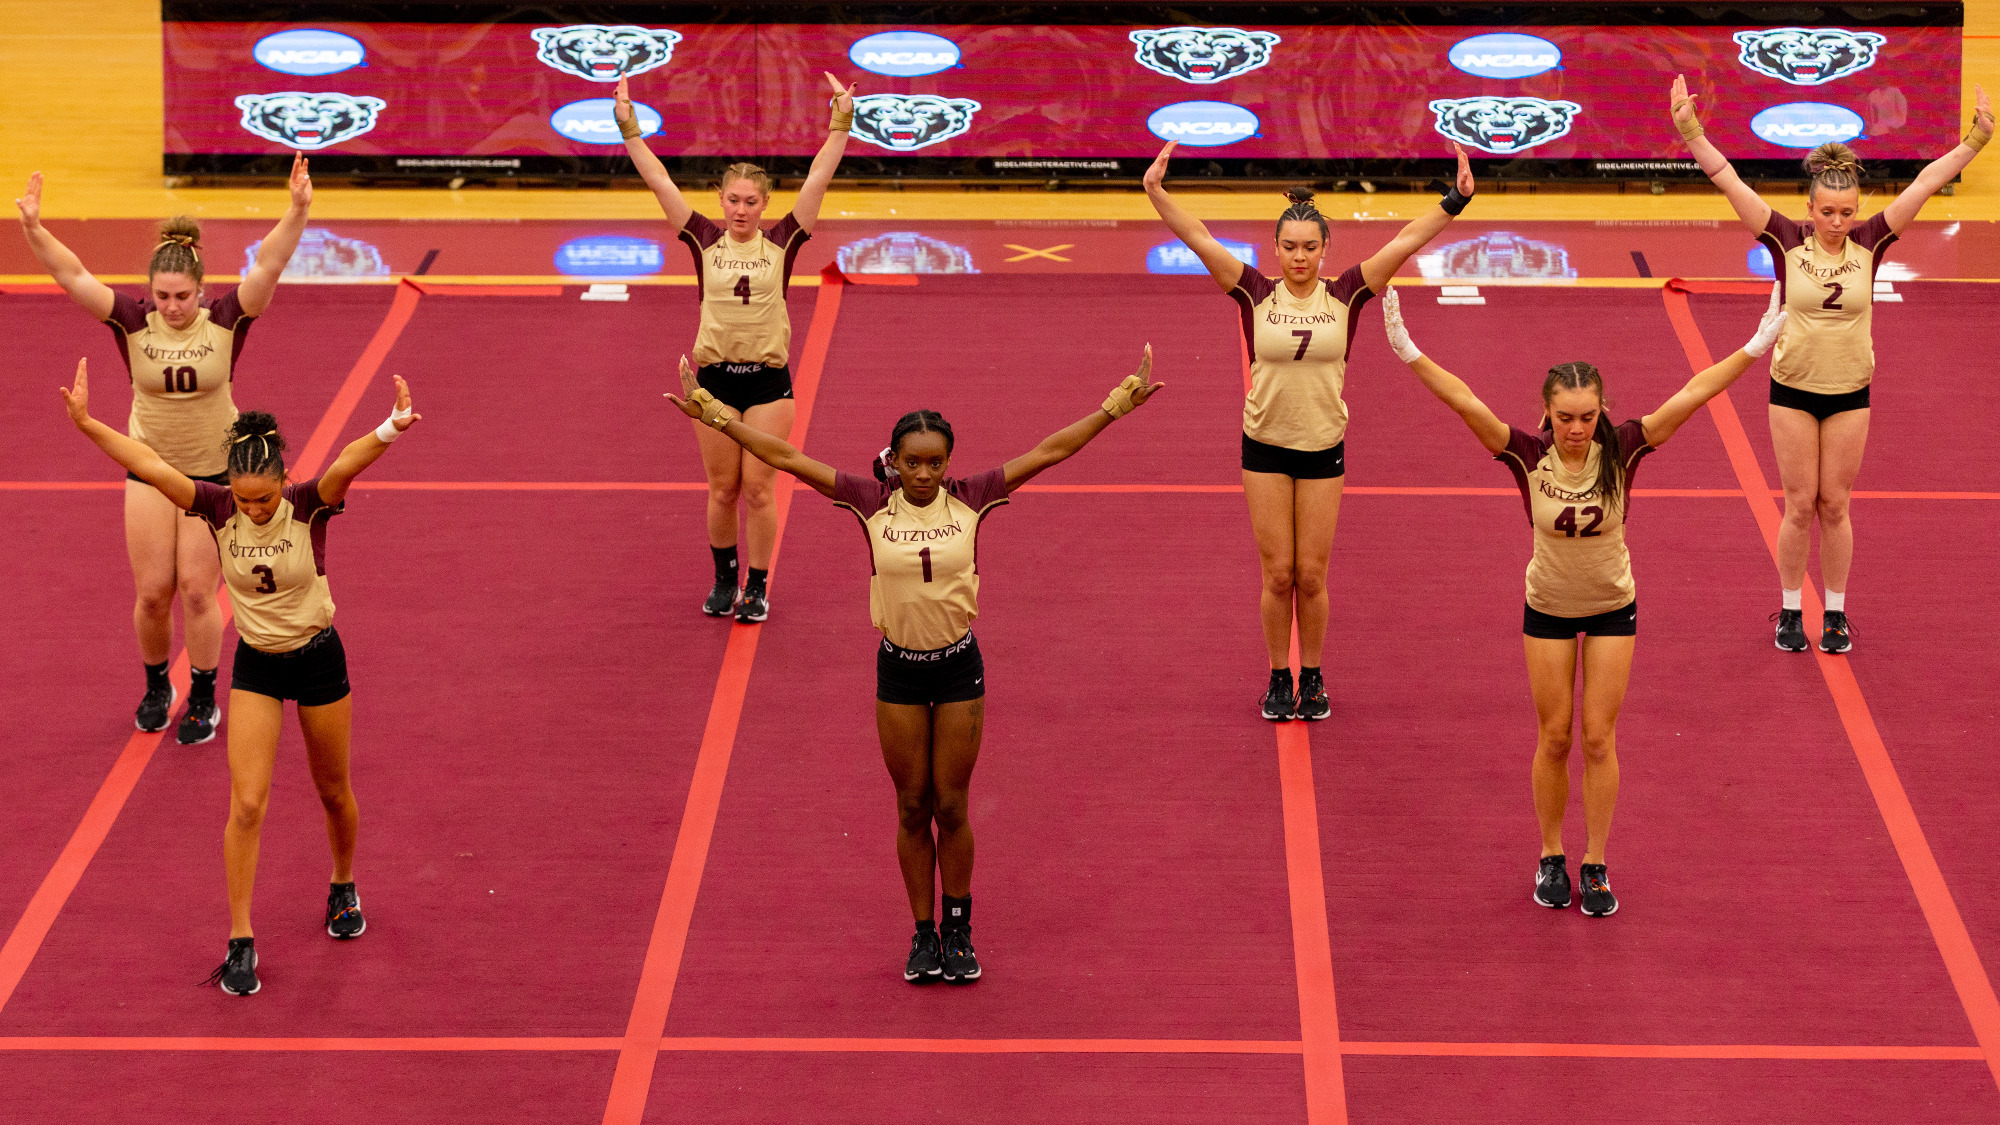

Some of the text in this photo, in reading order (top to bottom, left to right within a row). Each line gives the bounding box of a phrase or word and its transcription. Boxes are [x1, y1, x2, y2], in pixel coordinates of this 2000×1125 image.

[267, 50, 361, 64] NCAA
[862, 52, 957, 65] NCAA
[1461, 54, 1557, 67] NCAA
[563, 119, 659, 133] NCA
[1160, 122, 1256, 135] NCAA
[1763, 123, 1859, 136] NCAA
[1596, 162, 1702, 170] SIDELINEINTERACTIVE.C
[713, 255, 772, 270] KUTZTOWN
[1799, 258, 1862, 278] KUTZTOWN
[733, 275, 751, 305] 4
[1822, 282, 1843, 310] 2
[1266, 310, 1337, 325] KUTZTOWN
[144, 343, 215, 360] KUTZTOWN
[1291, 329, 1313, 361] 7
[726, 363, 762, 374] NIKE
[162, 366, 198, 393] 10
[1554, 505, 1604, 538] 42
[881, 520, 964, 542] KUTZTOWN
[918, 546, 933, 583] 1
[251, 564, 277, 594] 3
[899, 631, 973, 662] NIKE PRO
